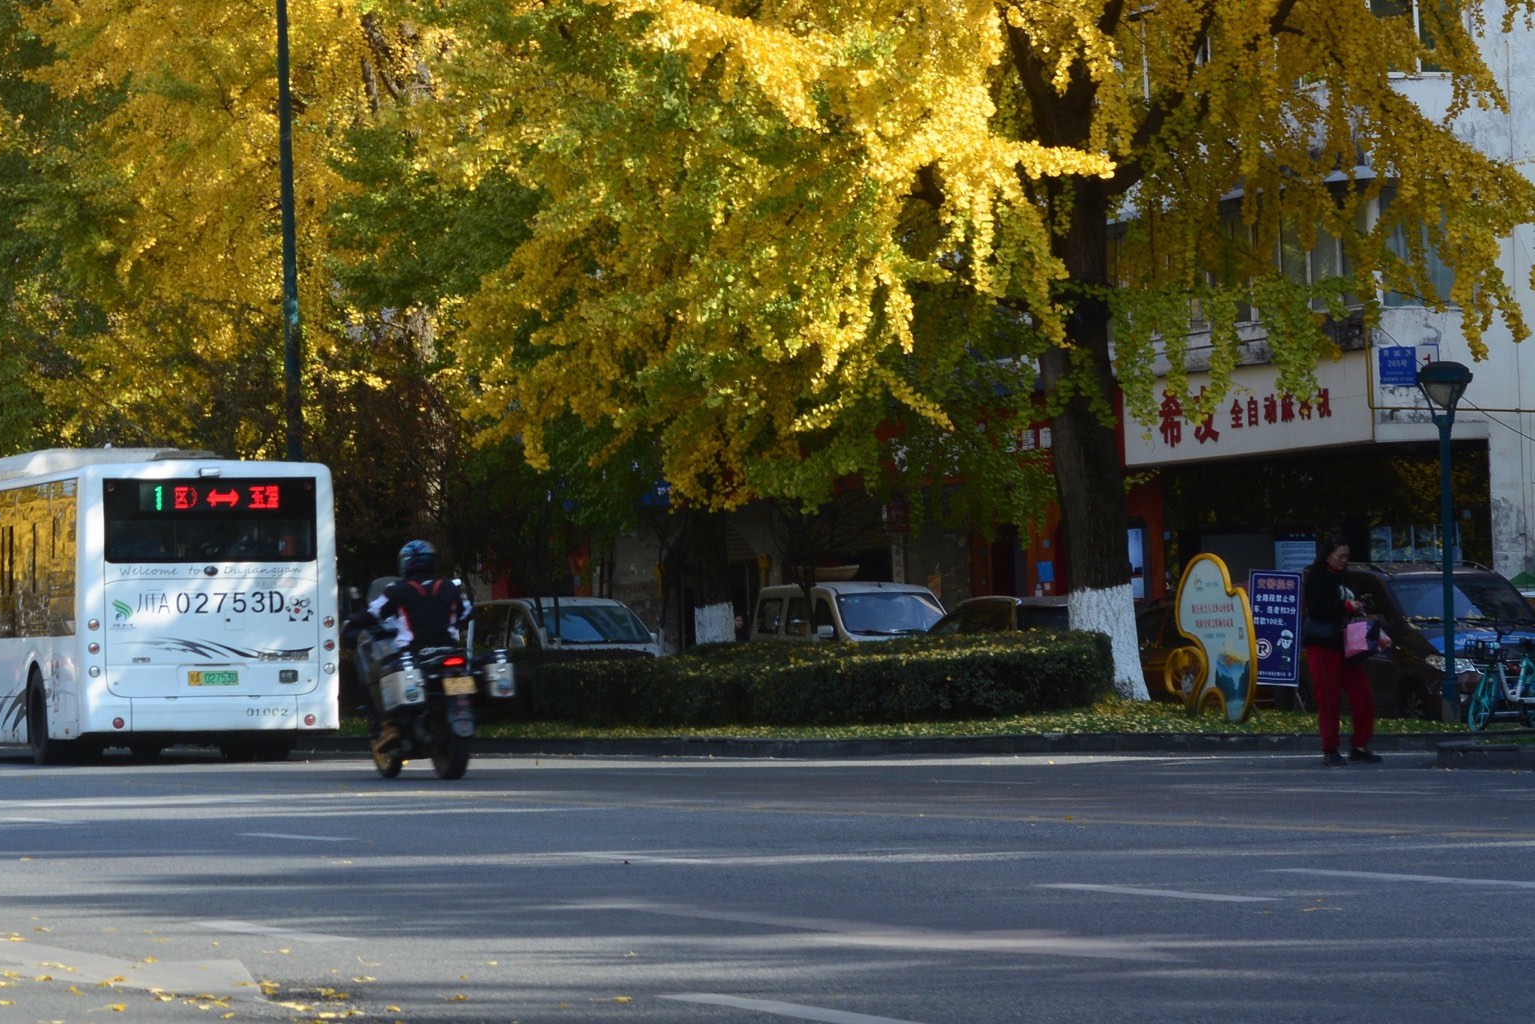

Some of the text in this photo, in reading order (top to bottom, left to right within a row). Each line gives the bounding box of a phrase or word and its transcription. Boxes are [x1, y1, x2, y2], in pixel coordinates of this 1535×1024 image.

[154, 485, 162, 510] 1
[119, 565, 302, 578] Welcome to Dujiangyan
[1256, 593, 1296, 604] 全路段禁止停
